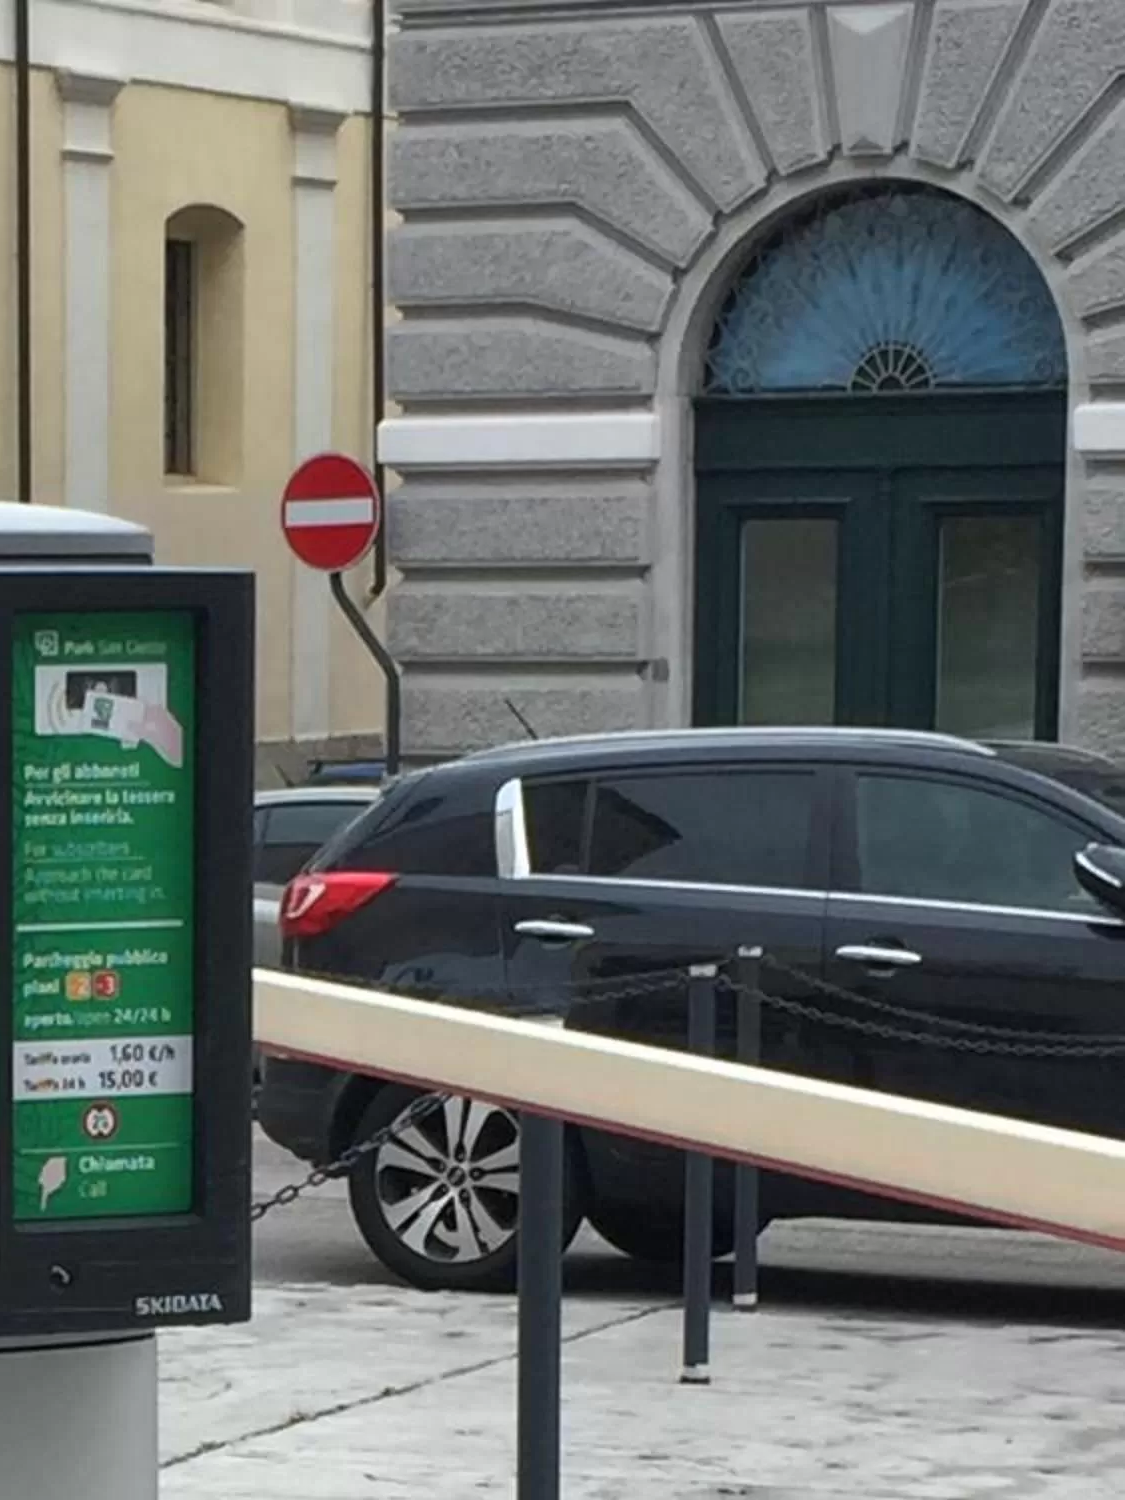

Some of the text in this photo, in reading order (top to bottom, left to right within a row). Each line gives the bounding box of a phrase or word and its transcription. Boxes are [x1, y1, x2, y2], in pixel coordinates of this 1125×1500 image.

[23, 762, 140, 784] Per gli abbonati
[24, 788, 175, 806] Avvicinare la tessera
[24, 812, 67, 827] senza
[23, 949, 168, 969] Parcheggio pubblico
[23, 978, 61, 997] piani
[113, 1007, 158, 1025] 24/24
[161, 1007, 172, 1022] h
[110, 1043, 144, 1064] 1,60
[148, 1043, 176, 1063] €/h
[98, 1069, 144, 1090] 15,00
[148, 1070, 159, 1087] €
[79, 1155, 156, 1174] Chiamata
[79, 1180, 108, 1198] Call
[135, 1293, 223, 1316] SKIDATA
